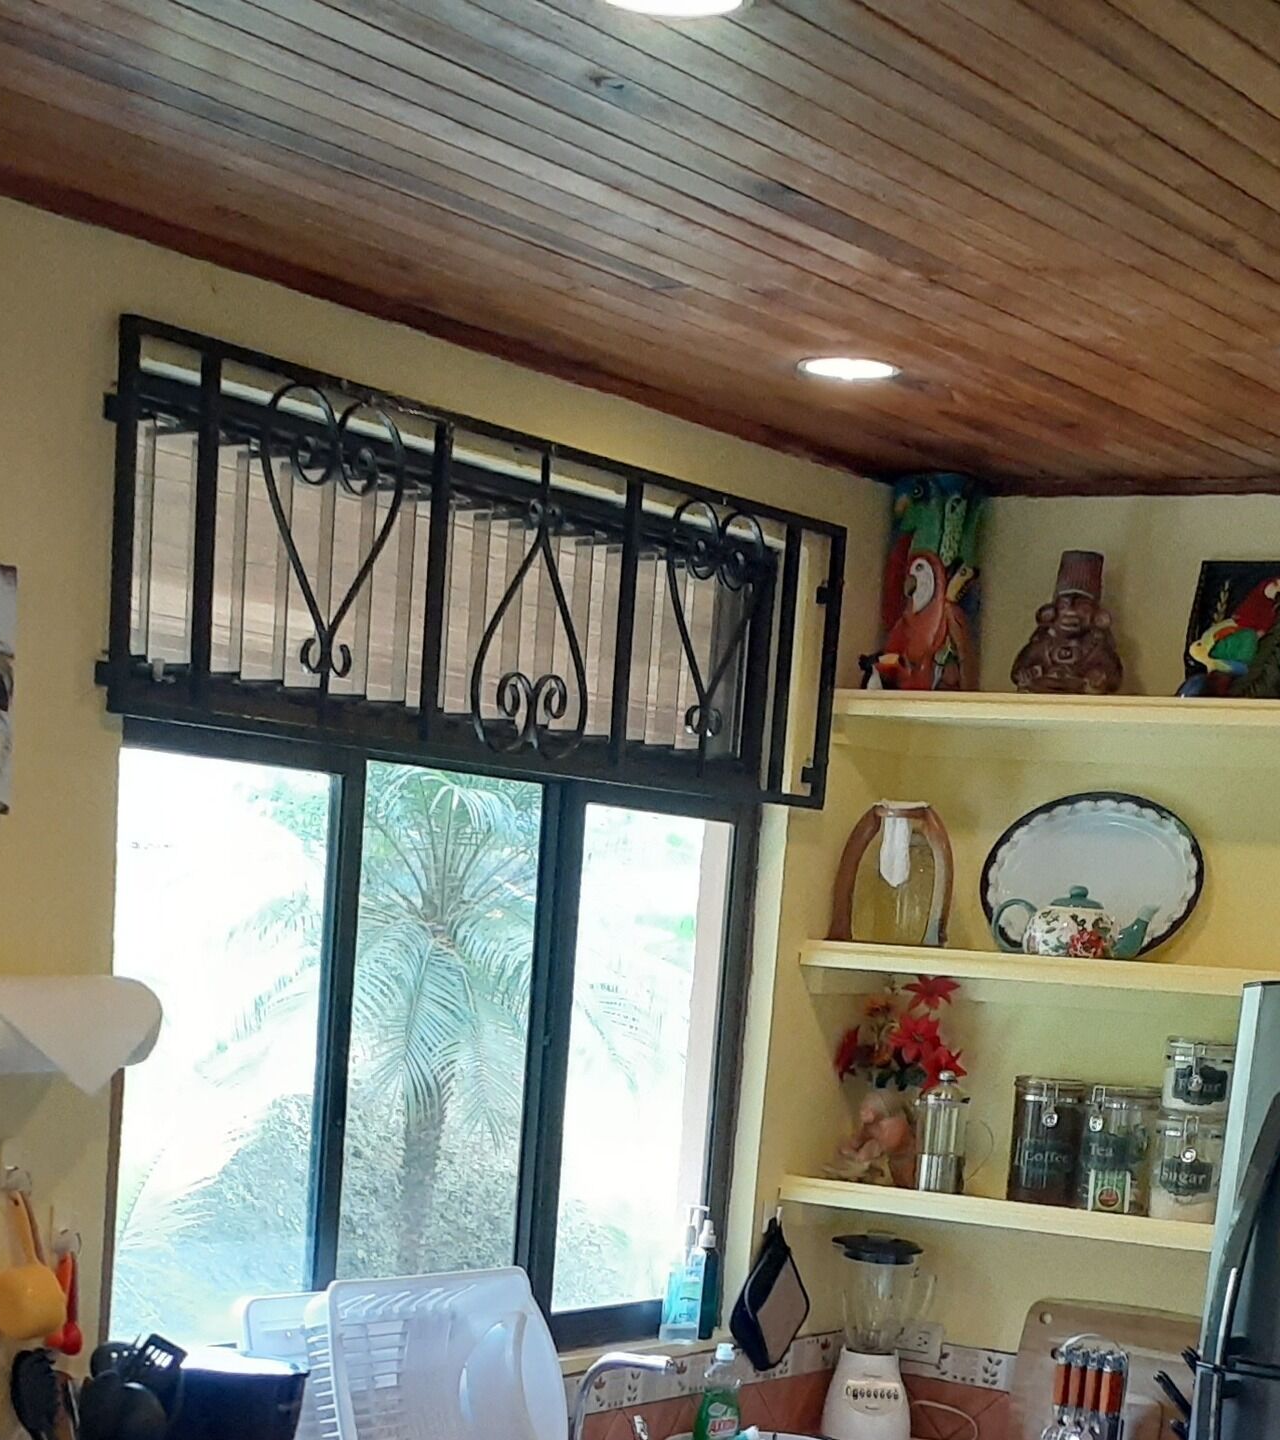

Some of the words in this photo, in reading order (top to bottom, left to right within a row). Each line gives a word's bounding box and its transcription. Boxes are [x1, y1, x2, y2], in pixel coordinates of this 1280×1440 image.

[1177, 1077, 1222, 1093] Fur
[1024, 1150, 1068, 1163] Coffee
[1088, 1141, 1113, 1157] Tea
[1160, 1167, 1207, 1187] Sugar
